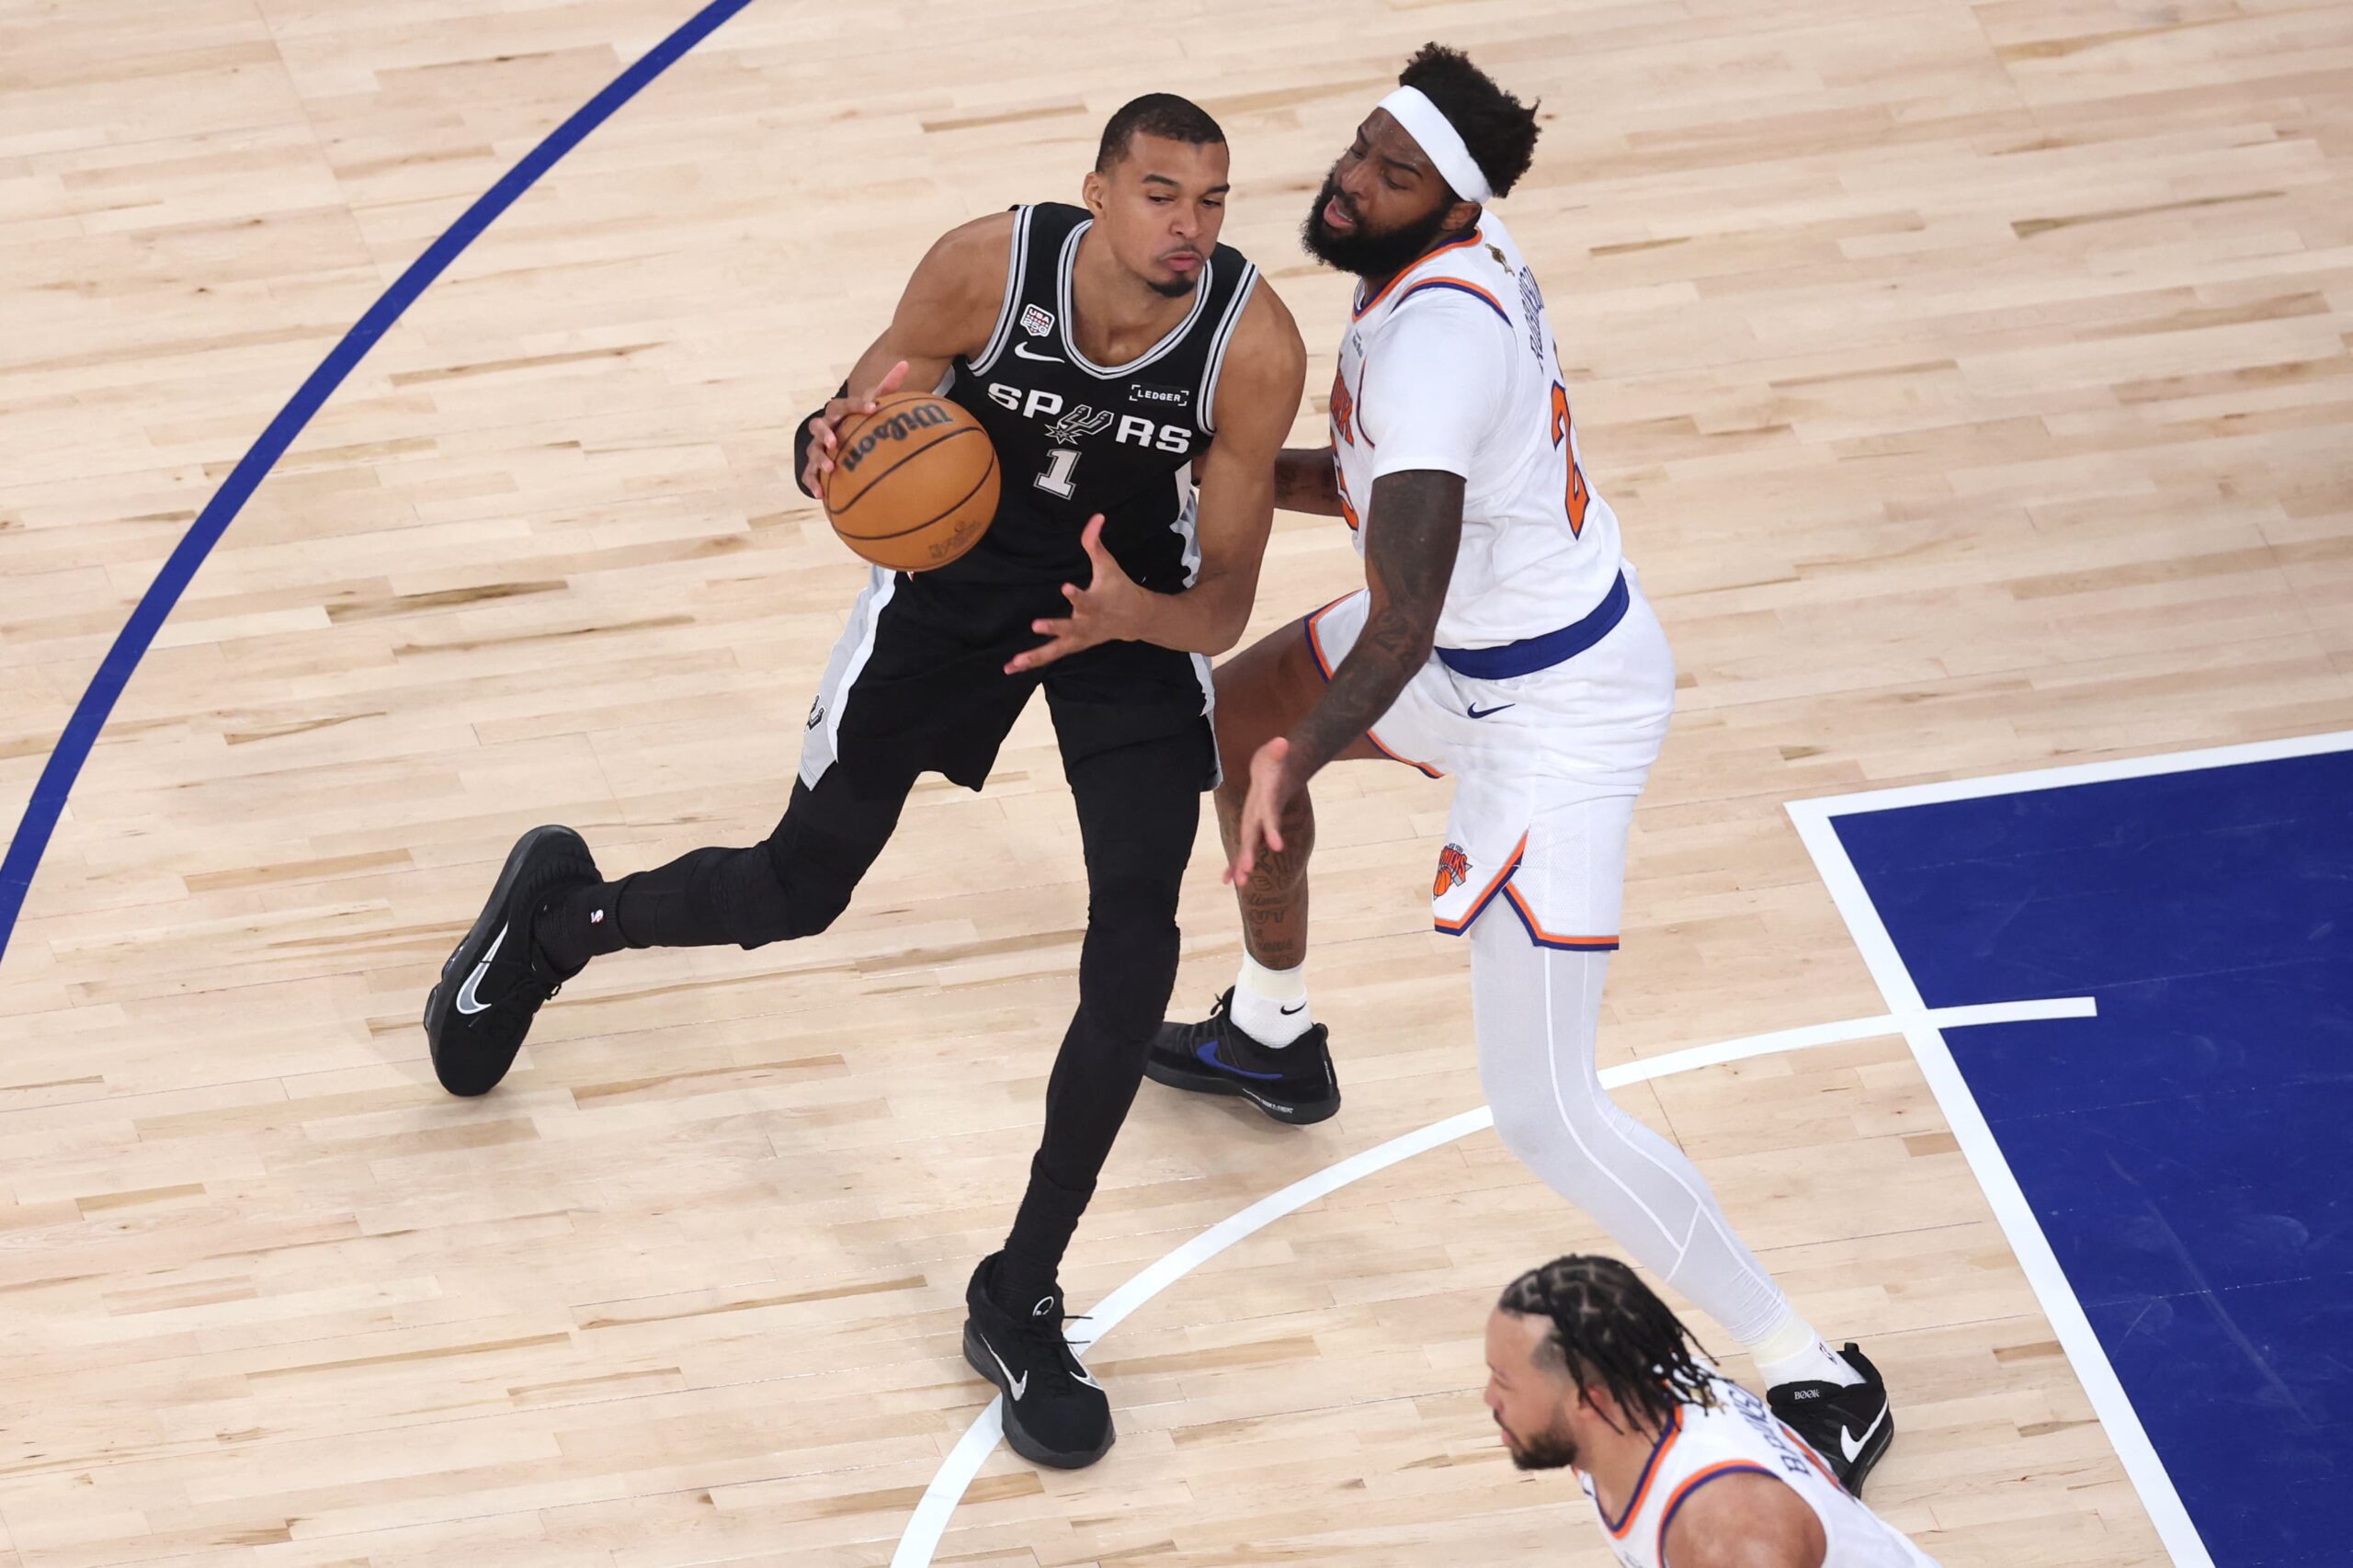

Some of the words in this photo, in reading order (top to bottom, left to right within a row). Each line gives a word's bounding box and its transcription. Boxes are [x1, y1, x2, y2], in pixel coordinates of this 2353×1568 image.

[1029, 308, 1050, 324] USA
[1023, 317, 1048, 335] 250
[1137, 389, 1181, 403] LEDGER
[842, 403, 953, 472] Wilson
[1033, 448, 1083, 501] 1
[1794, 1389, 1820, 1400] BOOK
